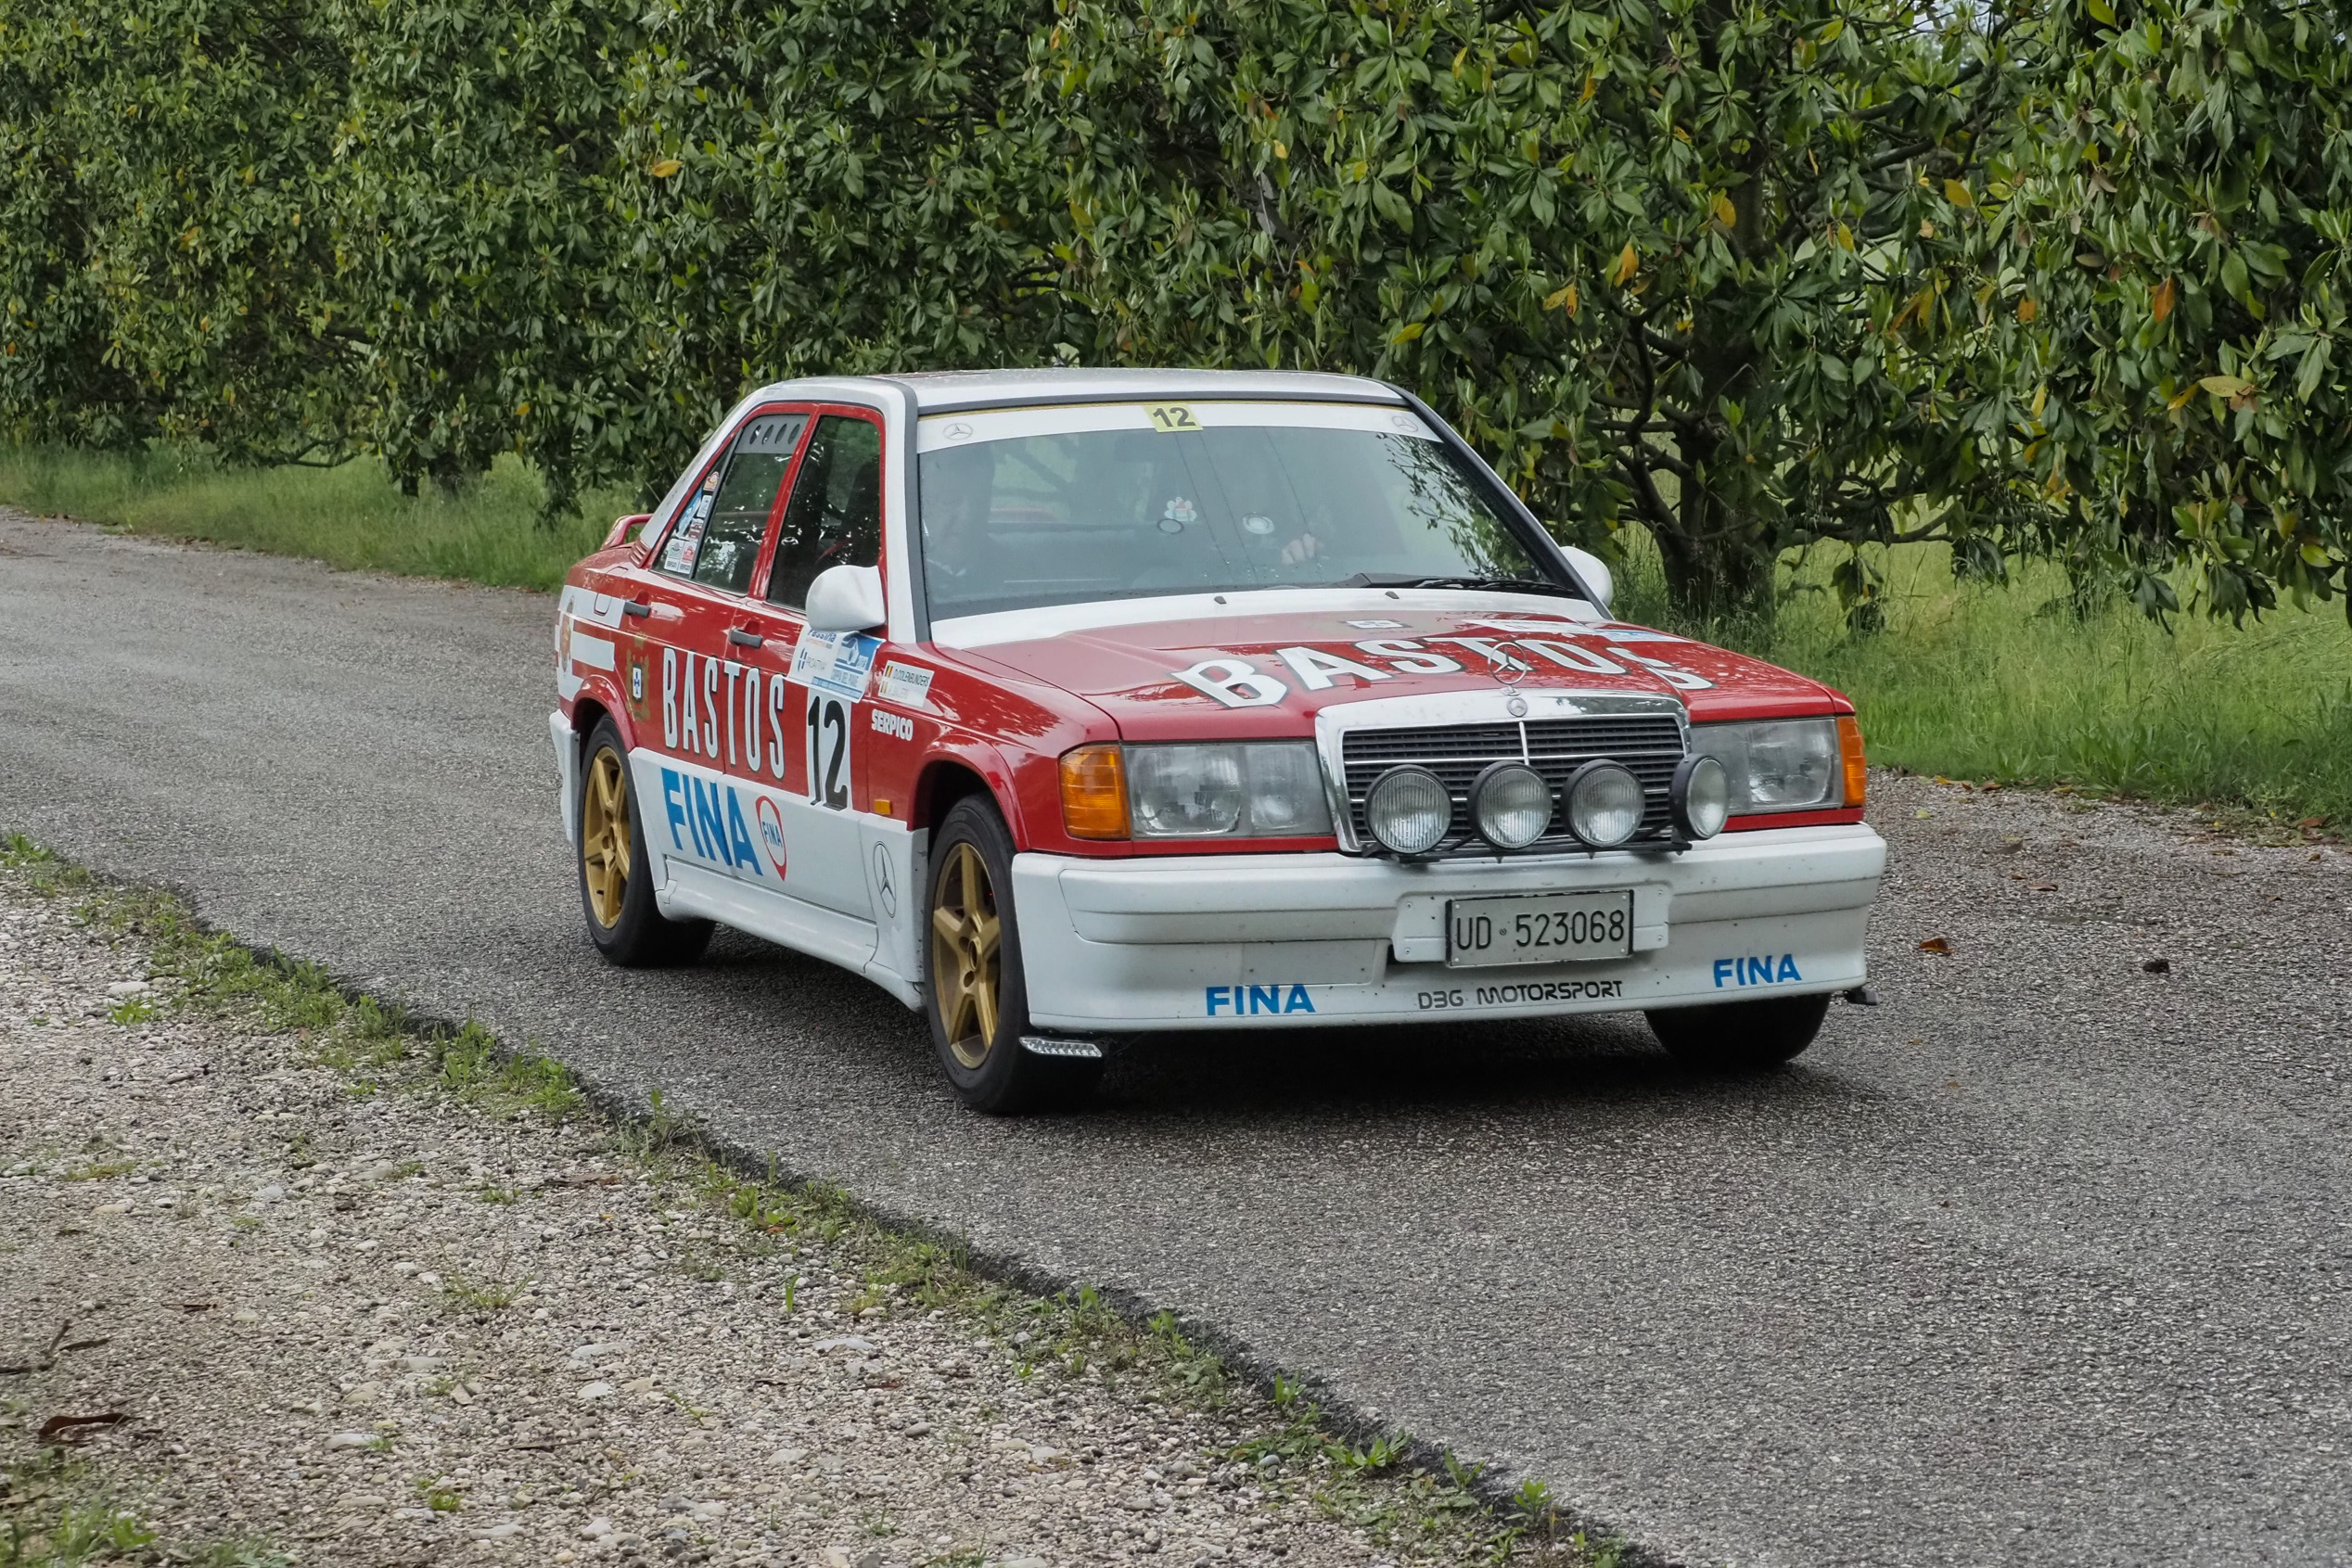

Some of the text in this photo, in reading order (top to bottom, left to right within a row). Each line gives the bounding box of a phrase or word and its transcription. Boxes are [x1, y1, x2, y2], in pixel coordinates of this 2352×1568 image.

[1152, 406, 1197, 427] 12
[1170, 636, 1715, 708] BASTOS
[662, 645, 786, 782] BASTOS
[872, 708, 914, 741] SERPICO
[808, 695, 848, 811] 12
[660, 767, 764, 876] FINA
[761, 821, 784, 848] FINA
[1456, 909, 1626, 950] UD 523068
[1713, 953, 1803, 988] FINA
[1206, 983, 1316, 1016] FINA
[1476, 980, 1623, 1006] MOTORSPORT
